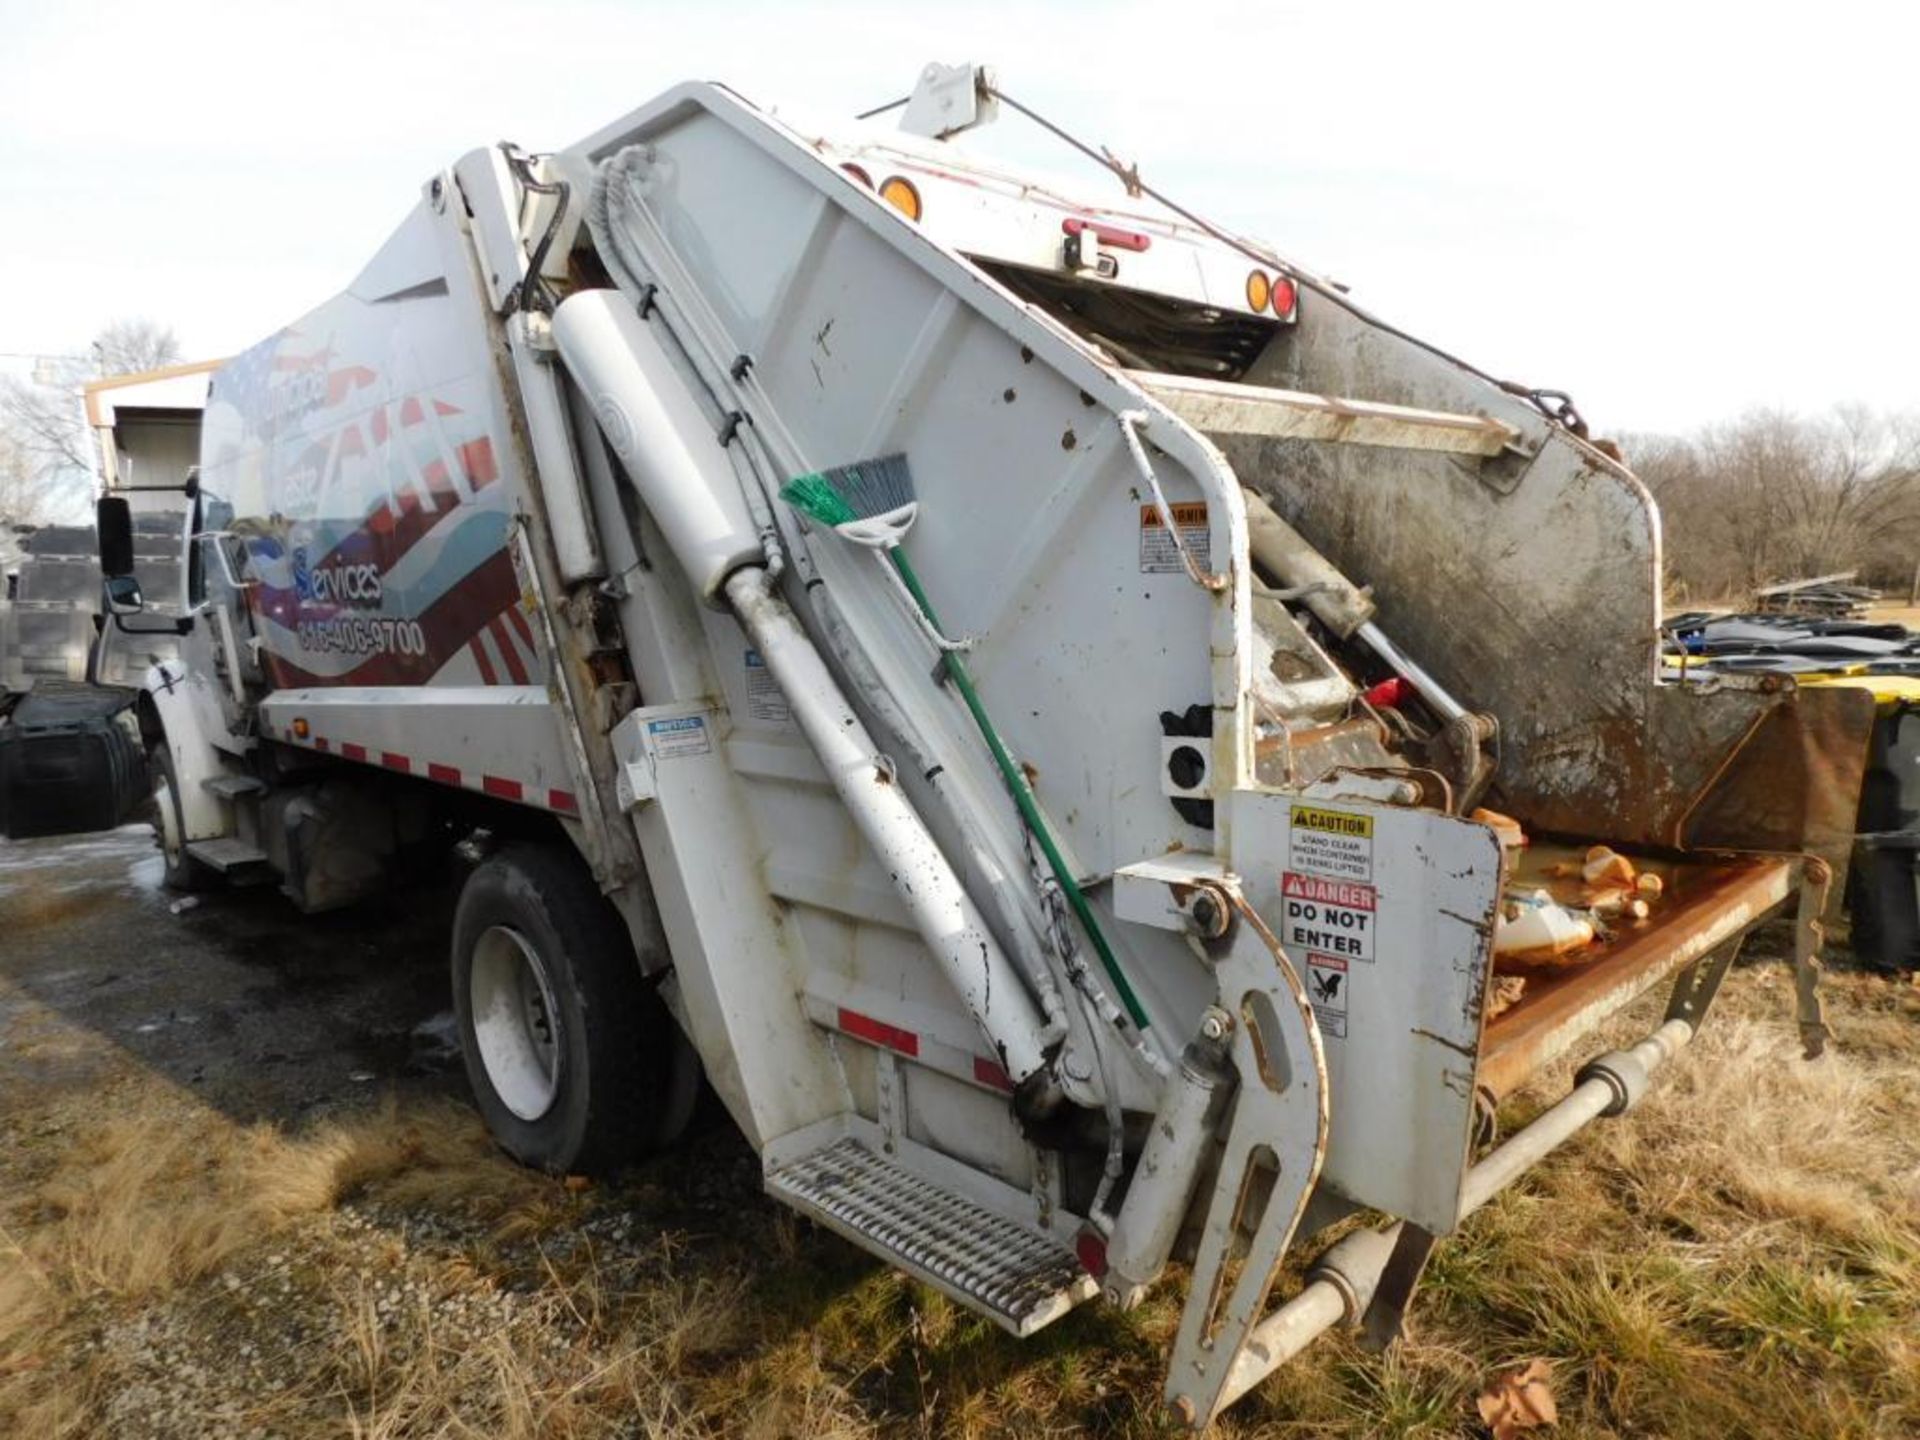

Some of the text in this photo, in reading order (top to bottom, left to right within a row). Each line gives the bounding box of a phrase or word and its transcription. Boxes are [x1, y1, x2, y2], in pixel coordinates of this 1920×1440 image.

[293, 546, 382, 602] Services
[1309, 812, 1366, 834] CAUTION
[1301, 835, 1360, 851] STAND CLEAR
[1304, 881, 1373, 909] DANGER
[1289, 902, 1368, 931] DO NOT
[1294, 927, 1362, 955] ENTER
